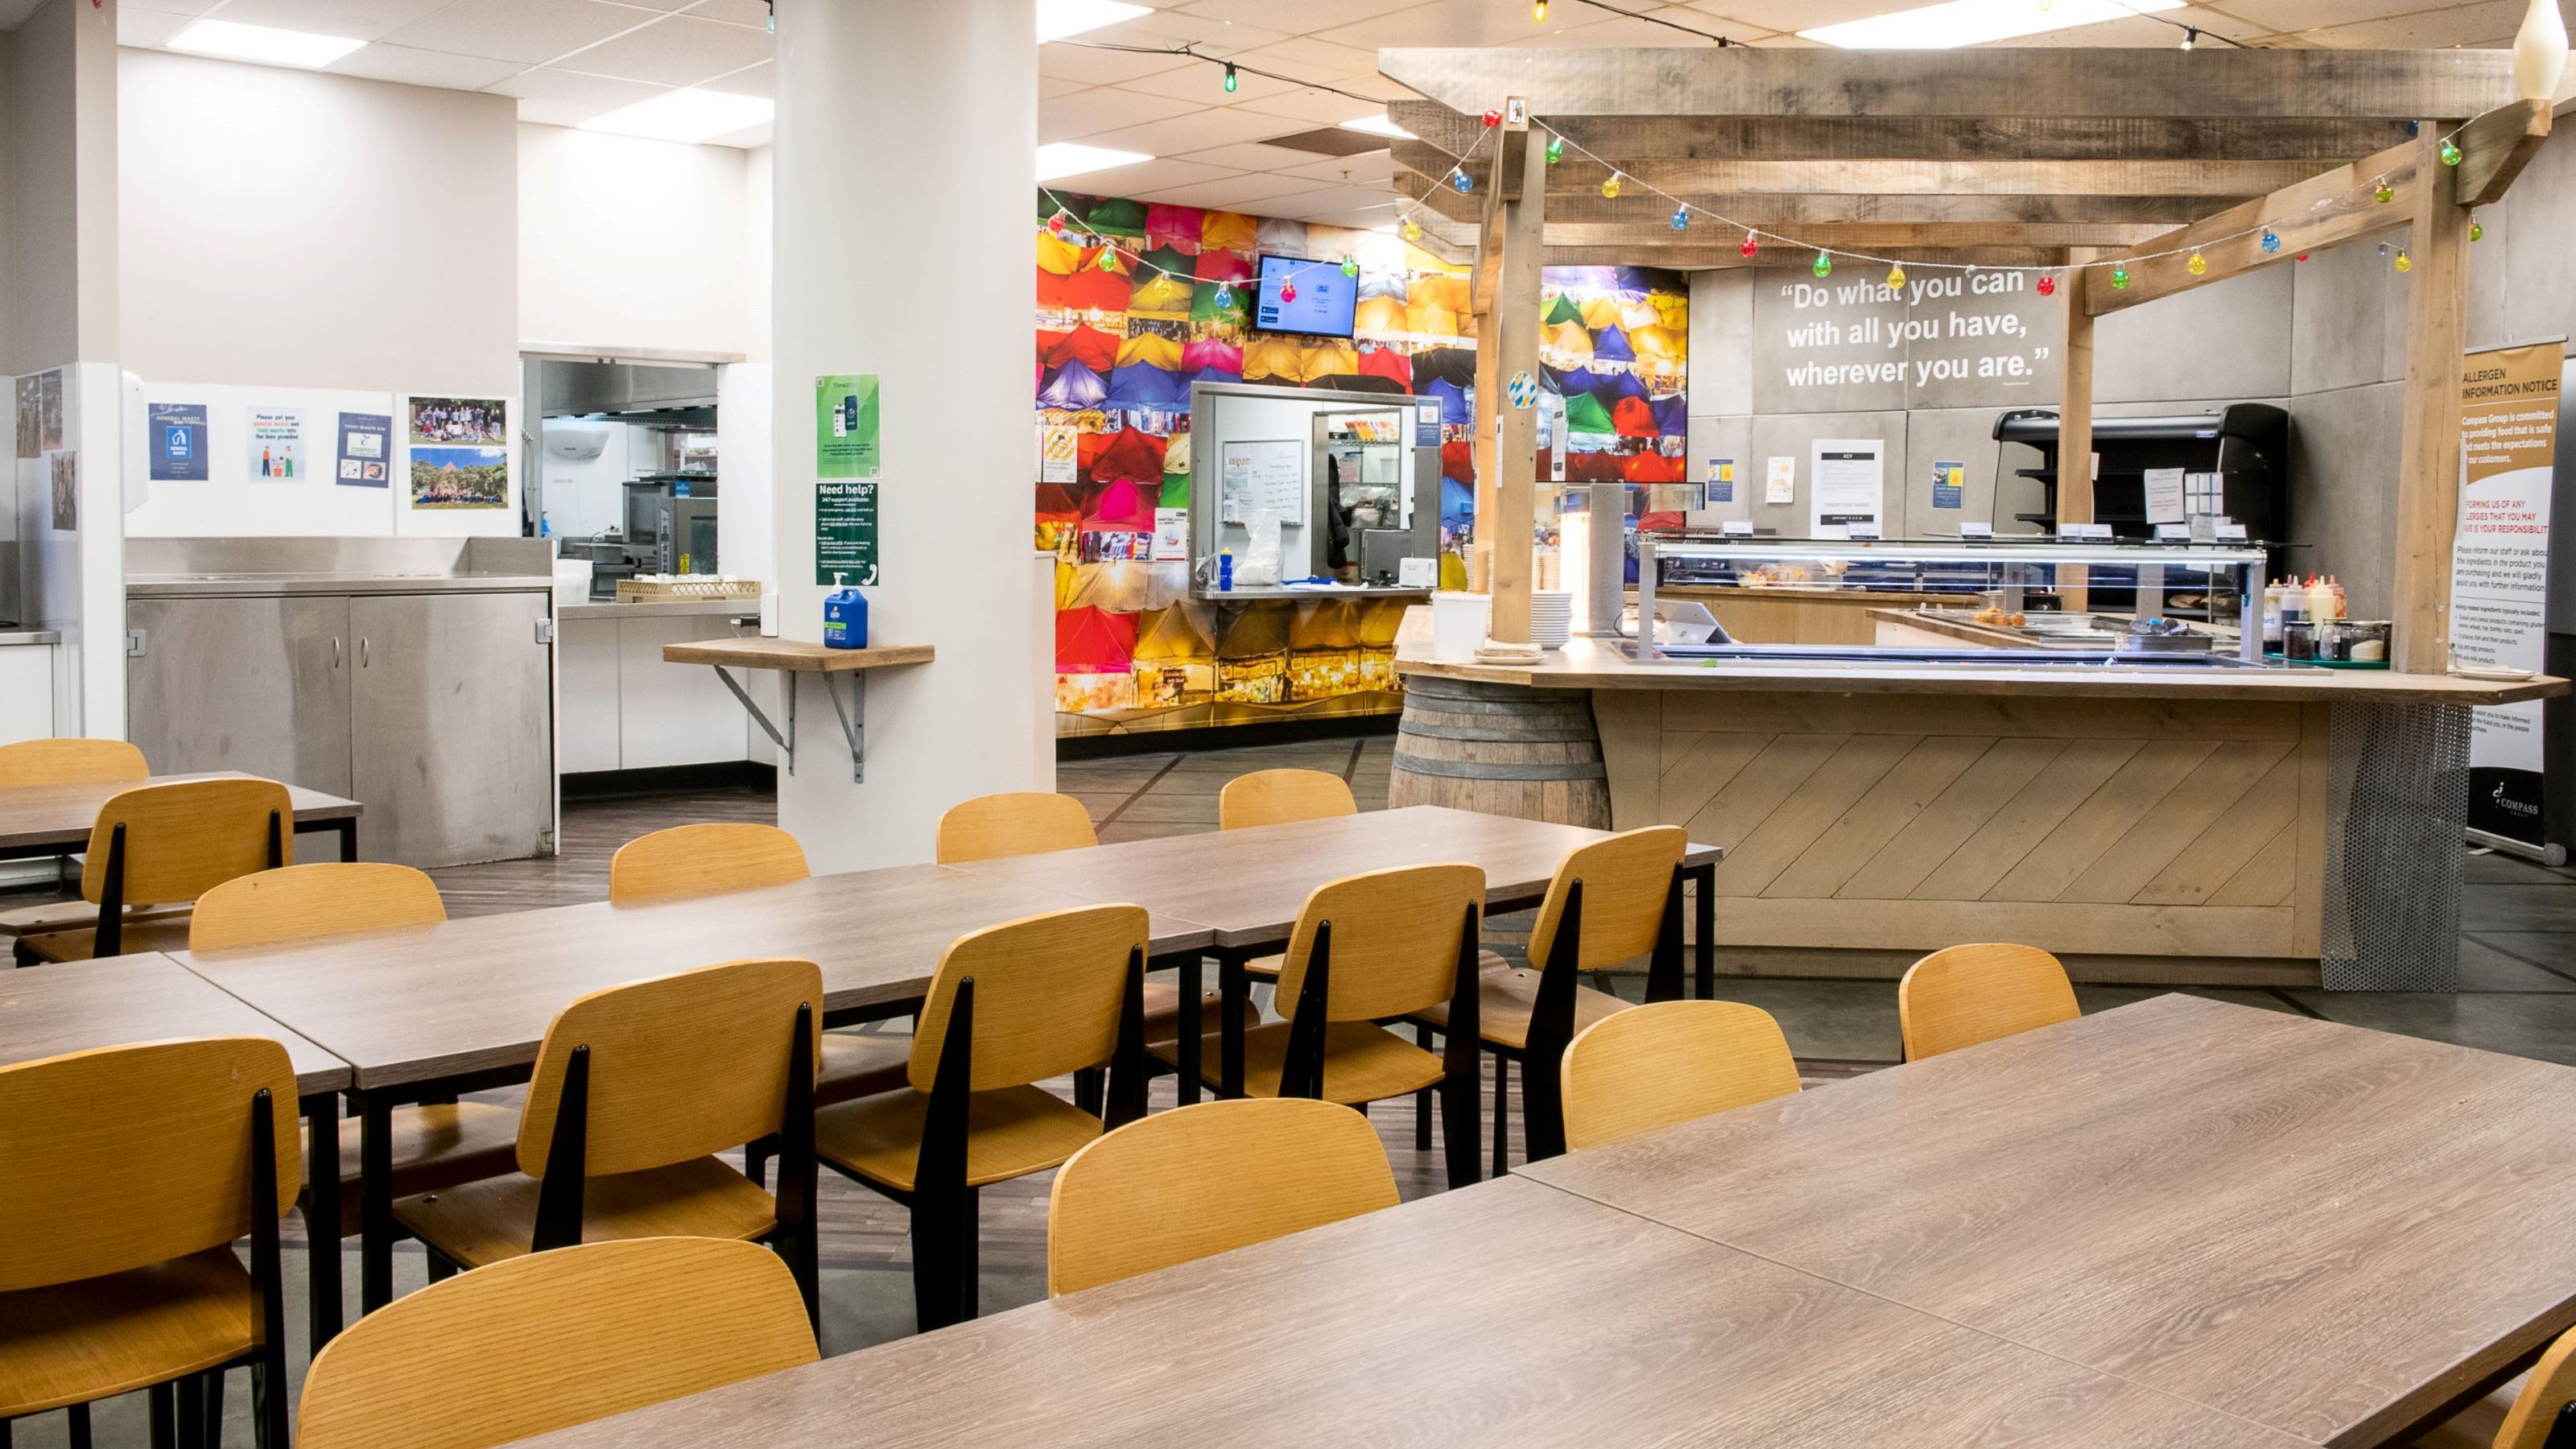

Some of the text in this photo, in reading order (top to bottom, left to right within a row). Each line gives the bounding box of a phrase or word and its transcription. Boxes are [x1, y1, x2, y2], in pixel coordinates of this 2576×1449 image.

[1909, 276, 1962, 306] you
[1971, 270, 2024, 295] can
[1786, 312, 2027, 349] with all you have,
[1785, 361, 1909, 387] wherever
[1916, 358, 1969, 387] you
[2462, 368, 2506, 383] ALLERGEN
[2462, 379, 2557, 399] INFORMATION NOTICE
[2462, 409, 2554, 426] Compass Group is committed
[2469, 427, 2496, 439] providing
[2498, 427, 2513, 436] food
[2514, 426, 2527, 435] that
[2529, 425, 2535, 433] is
[2536, 423, 2552, 433] safe
[2491, 441, 2502, 449] the
[2503, 438, 2547, 450] expectations
[2478, 455, 2512, 464] customers.
[819, 485, 873, 496] Need help?
[2490, 513, 2505, 521] THAT
[2508, 513, 2520, 521] YOU
[2522, 513, 2537, 521] MAY
[2480, 525, 2496, 533] YOUR
[2499, 525, 2550, 534] RESPONSIBILIT
[2473, 547, 2488, 555] inform
[2500, 547, 2512, 555] staff
[2509, 560, 2531, 568] product
[2523, 572, 2542, 581] gladly
[2491, 581, 2509, 589] further
[2512, 716, 2531, 724] informed
[2501, 798, 2538, 815] COMPASS
